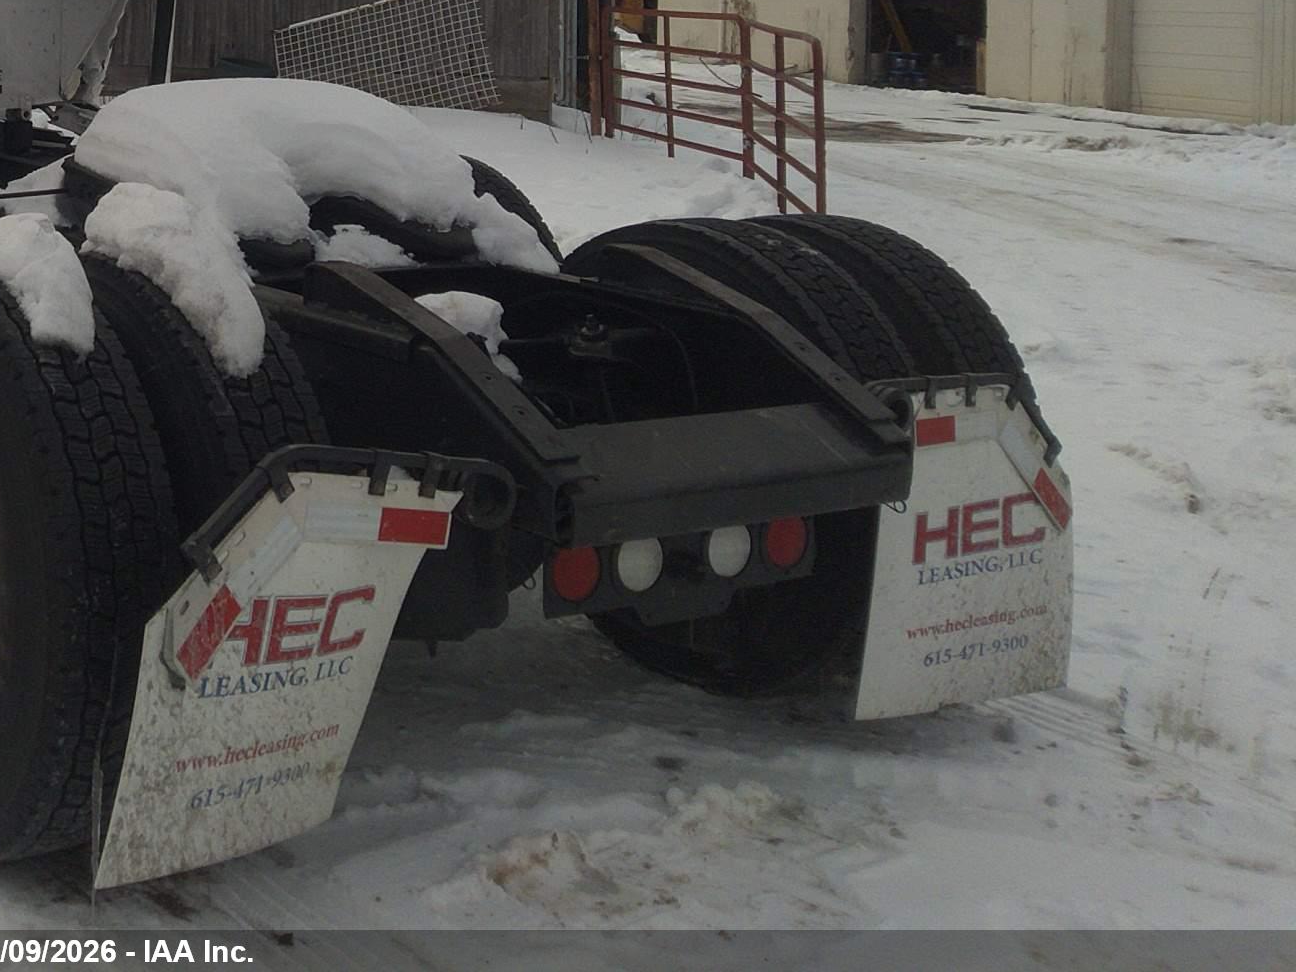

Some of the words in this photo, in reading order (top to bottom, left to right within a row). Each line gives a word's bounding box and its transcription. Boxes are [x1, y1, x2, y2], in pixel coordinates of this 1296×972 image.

[912, 492, 1047, 566] HEC
[918, 556, 1004, 586] LEASING,
[906, 604, 1048, 641] www.hecleasing.com
[923, 634, 1029, 668] 615-471-9300
[199, 667, 309, 699] LEASING,
[174, 722, 340, 774] www.hecleasing.com
[190, 761, 311, 810] 615-471-9300
